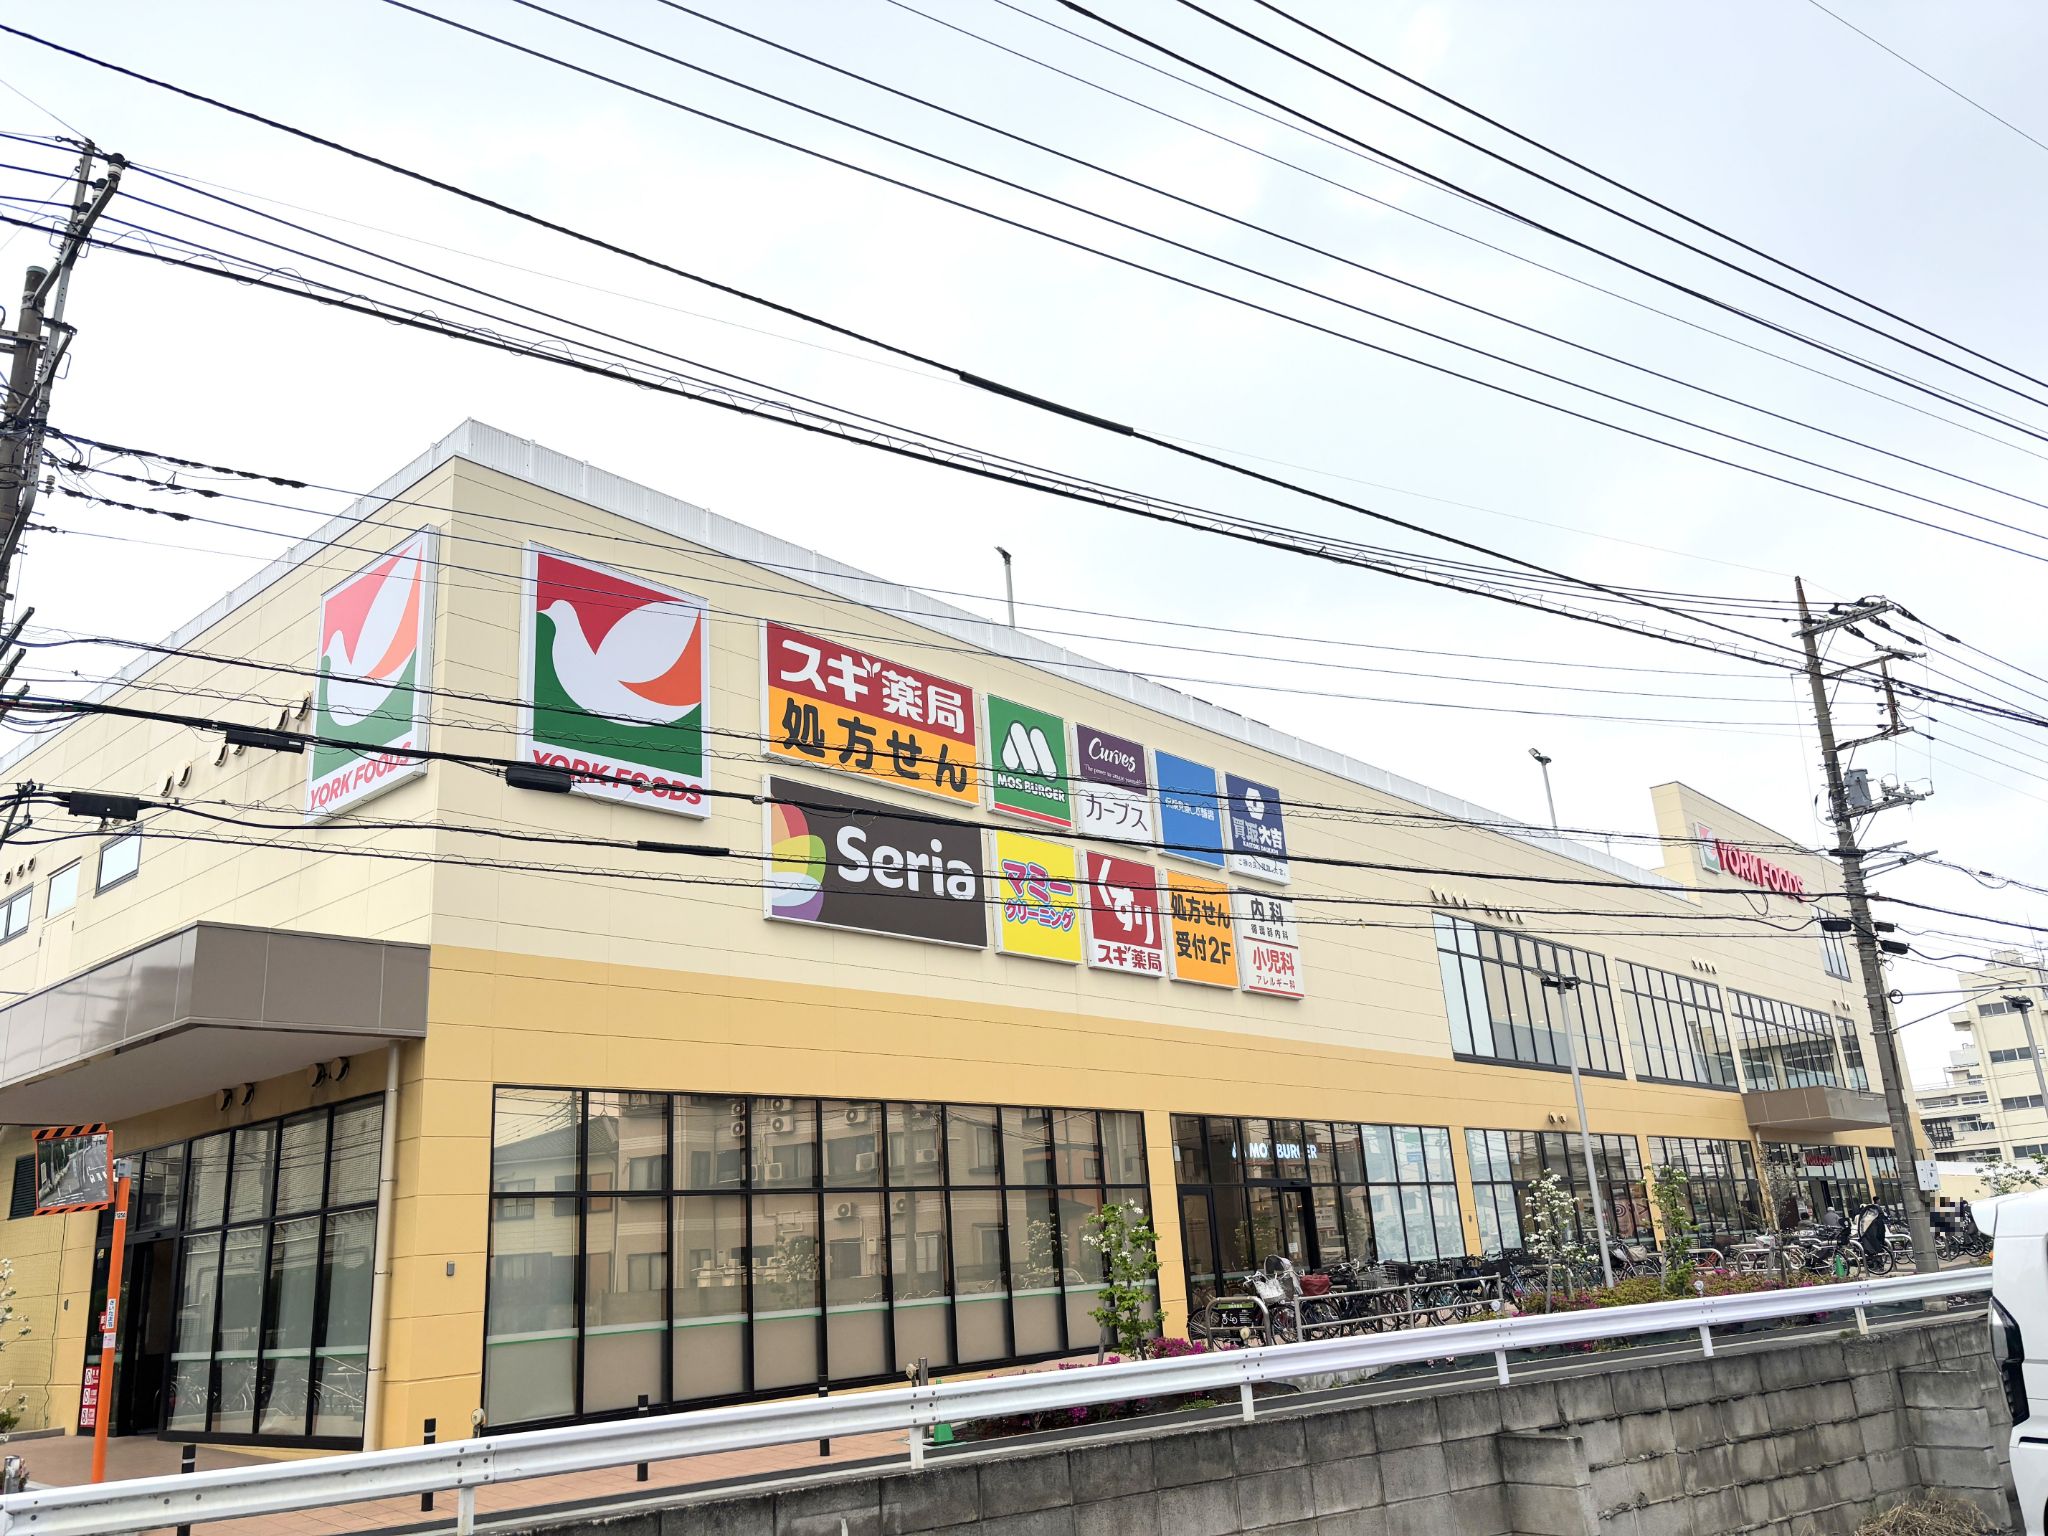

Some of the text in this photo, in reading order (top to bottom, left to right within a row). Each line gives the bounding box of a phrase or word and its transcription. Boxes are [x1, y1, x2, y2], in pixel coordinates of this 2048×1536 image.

[780, 639, 965, 734] スギ薬局
[782, 698, 966, 792] 処方せん
[1088, 737, 1136, 773] Curves
[309, 740, 412, 810] YORK FOODS
[612, 767, 702, 805] FOODS
[997, 774, 1065, 803] MOS BURGER
[1086, 794, 1148, 832] カーブス
[1232, 816, 1282, 850] 買取大吉
[836, 825, 976, 900] Seria
[1001, 859, 1074, 903] マミー
[1715, 838, 1808, 902] YORK FOODS
[1005, 898, 1076, 932] クリーニング
[1098, 858, 1155, 945] くすり
[1171, 892, 1231, 929] 処方せん
[1251, 897, 1284, 927] 内科
[1097, 944, 1163, 973] スギ薬局
[1175, 930, 1231, 965] 受付2F
[1253, 946, 1295, 977] 小児科
